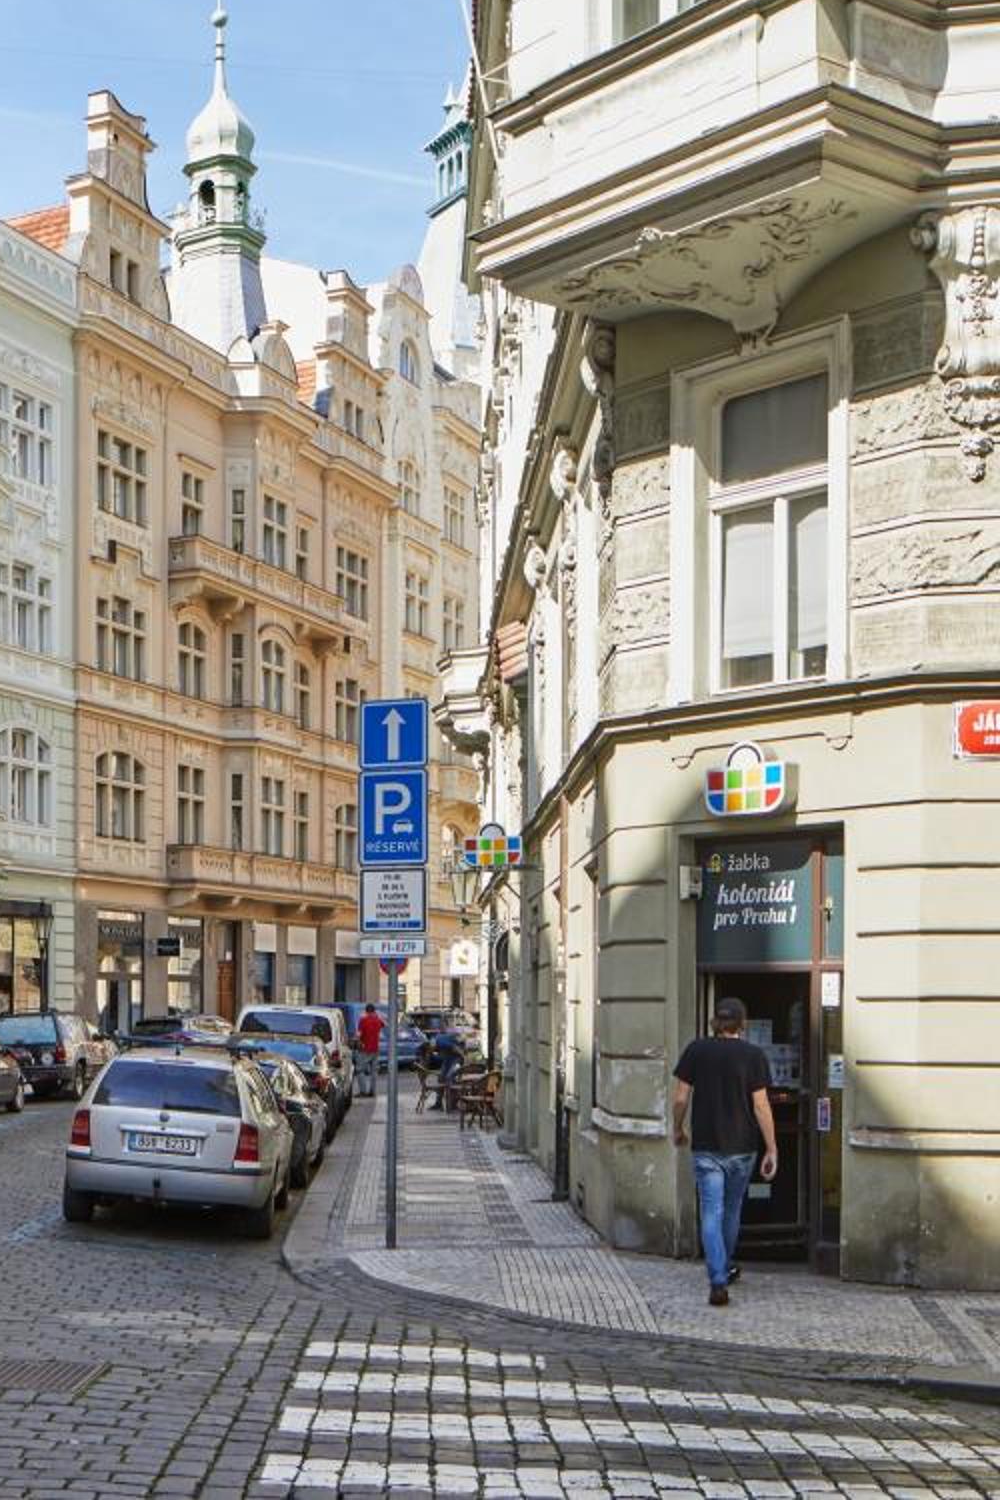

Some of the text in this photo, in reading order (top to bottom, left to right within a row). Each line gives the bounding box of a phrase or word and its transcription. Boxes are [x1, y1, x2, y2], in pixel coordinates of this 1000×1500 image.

[973, 709, 1000, 732] JÁ
[374, 782, 412, 835] P
[727, 852, 770, 871] žabka
[717, 879, 795, 905] koloniál
[713, 904, 797, 931] pro Prahu 1
